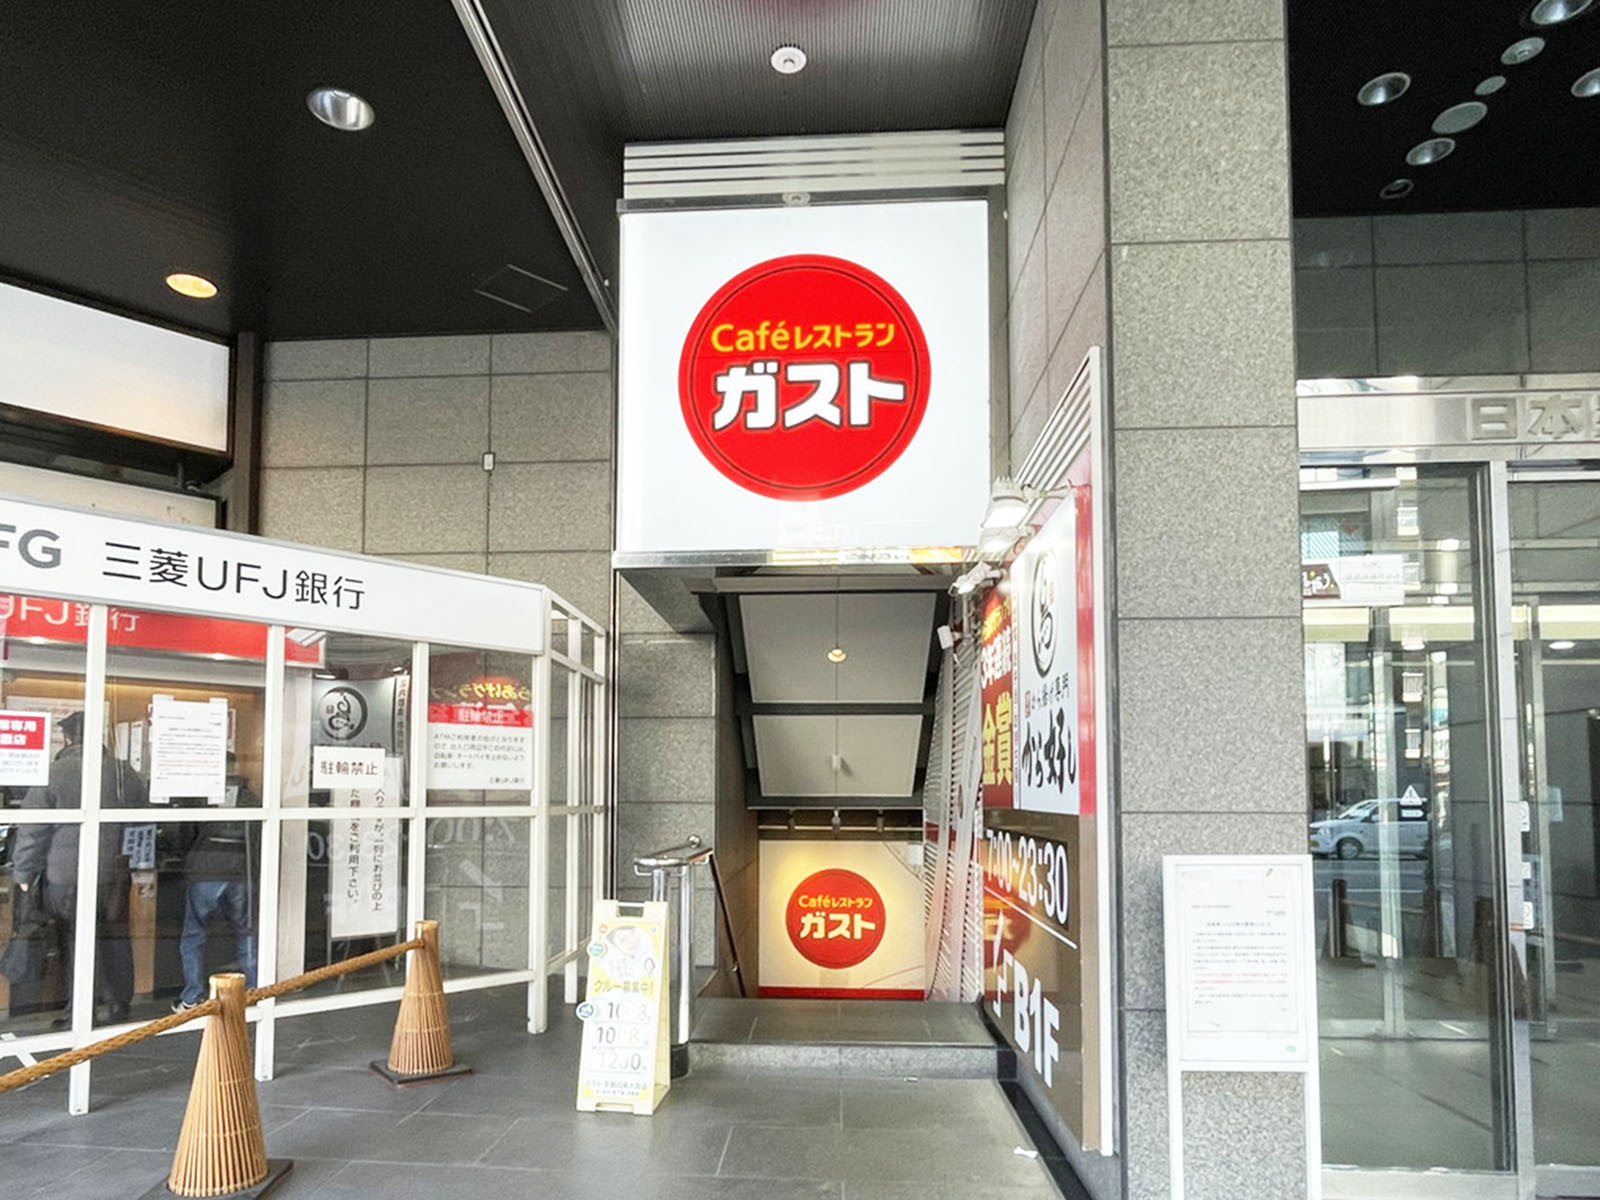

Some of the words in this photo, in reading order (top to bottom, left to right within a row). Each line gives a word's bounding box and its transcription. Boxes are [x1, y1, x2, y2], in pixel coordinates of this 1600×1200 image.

[711, 320, 895, 352] Caféレストラン
[712, 360, 906, 431] ガスト
[1470, 395, 1600, 441] 日本
[103, 540, 365, 610] 三菱UFJ銀行
[982, 691, 1012, 786] 金賞
[320, 760, 379, 777] 駐輪禁止
[800, 911, 876, 940] ガスト
[1013, 959, 1060, 1088] B1F
